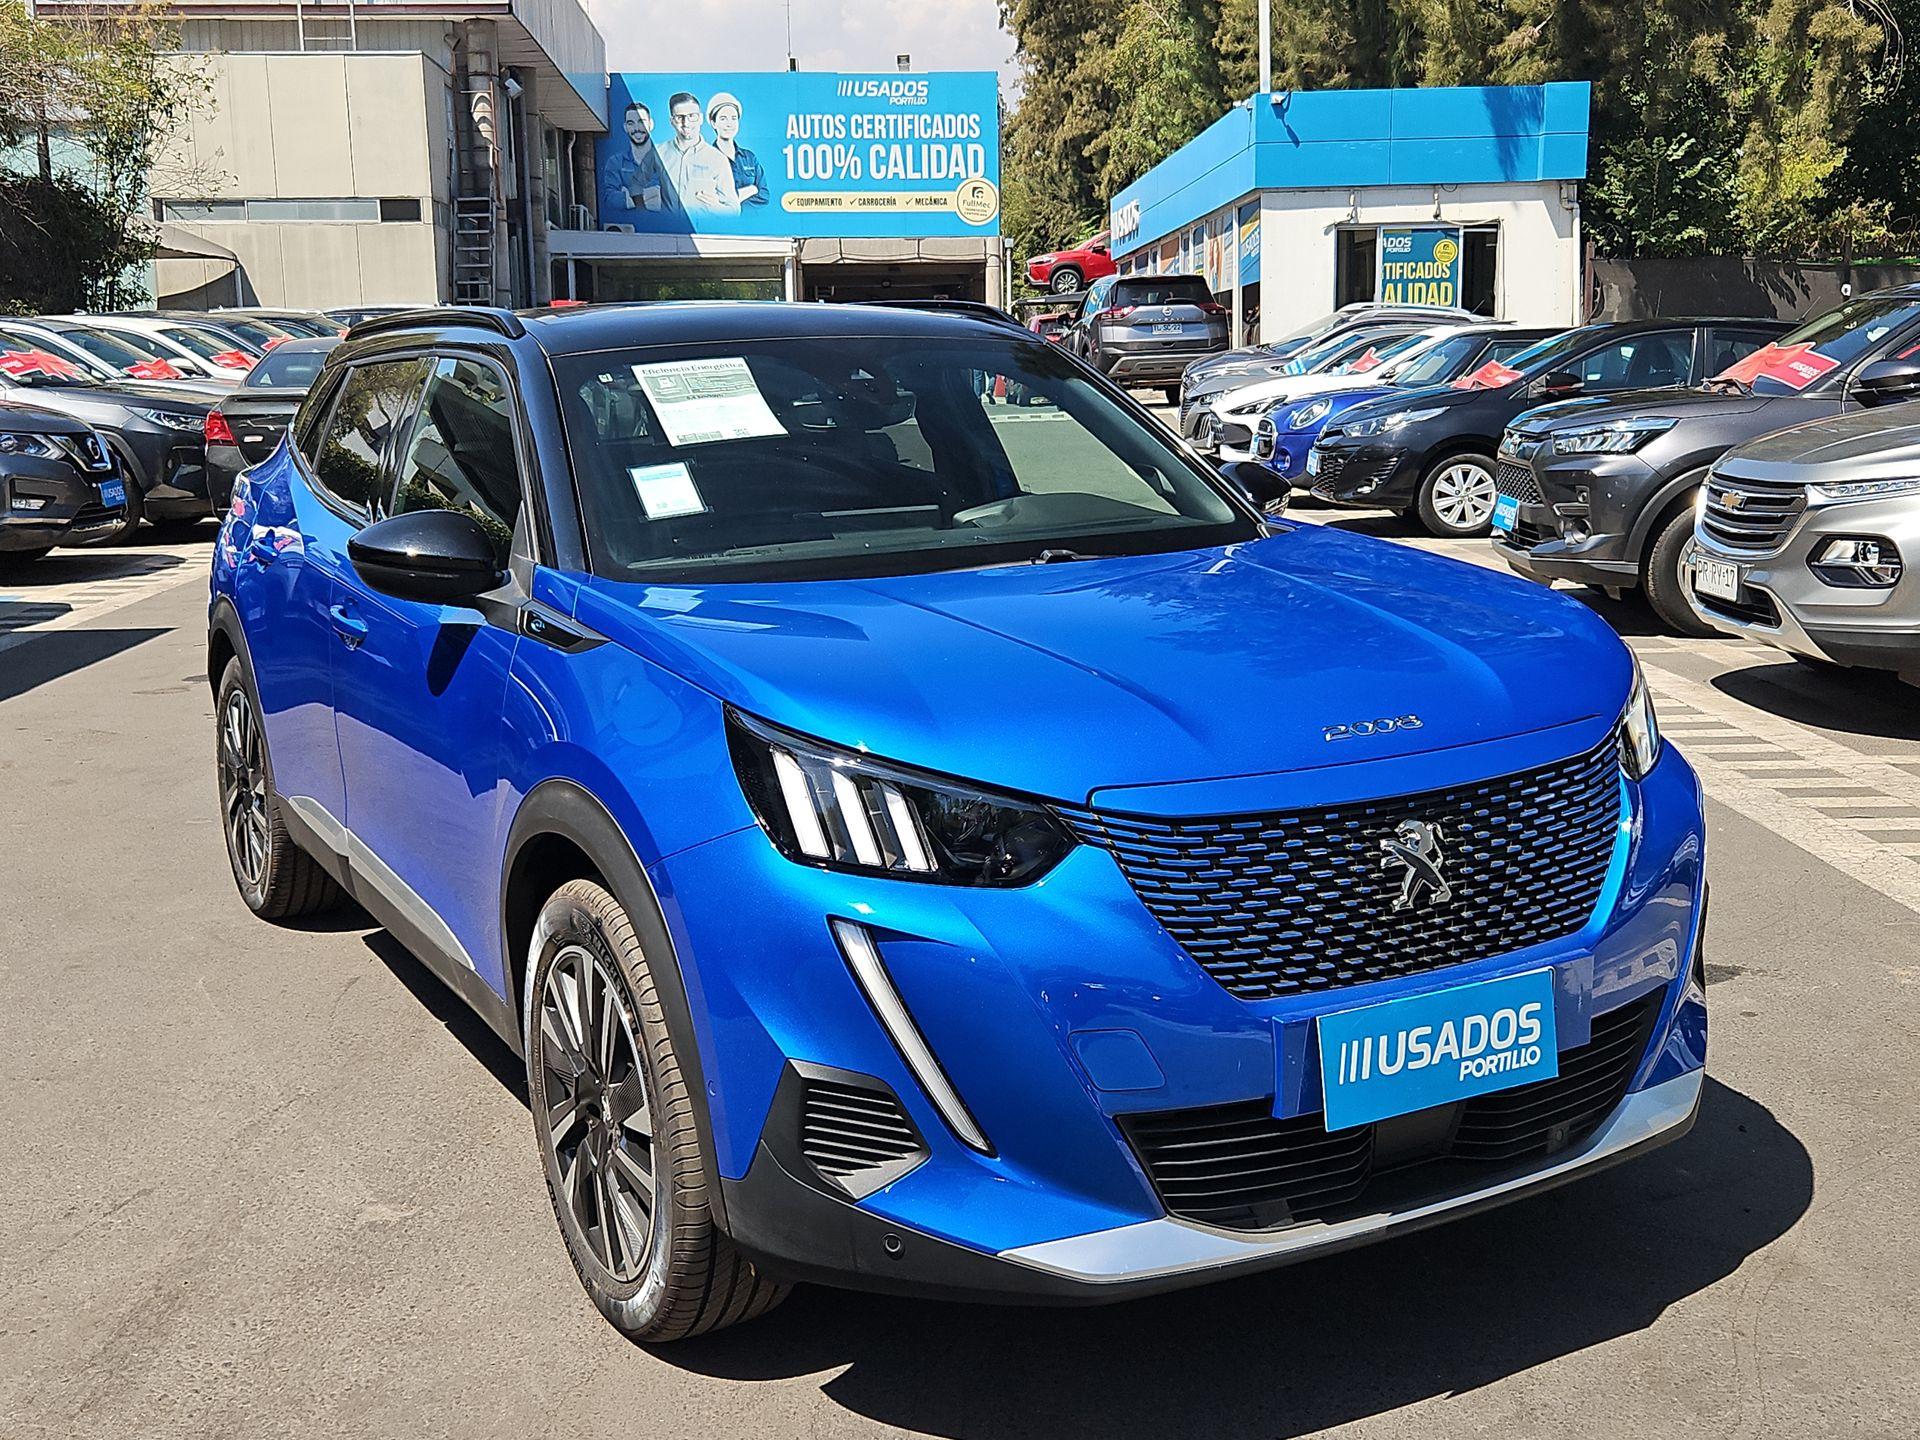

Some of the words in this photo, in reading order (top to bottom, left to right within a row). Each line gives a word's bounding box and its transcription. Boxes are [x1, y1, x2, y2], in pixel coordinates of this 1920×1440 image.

[854, 80, 929, 97] USADOS
[889, 96, 928, 106] PORTILLO
[786, 113, 846, 140] AUTOS
[850, 113, 981, 140] CERTIFICADOS
[782, 143, 862, 180] 100%
[868, 143, 985, 180] CALIDAD
[796, 197, 843, 207] EQUIPAMIENTO
[857, 194, 898, 207] CARROCERÍA
[914, 195, 948, 207] MECÁNICA
[962, 199, 991, 209] FullMec
[642, 367, 690, 375] Eficiencia
[1321, 714, 1424, 742] 2008
[1377, 1002, 1542, 1077] USADOS
[1458, 1045, 1542, 1082] PORTILLO
